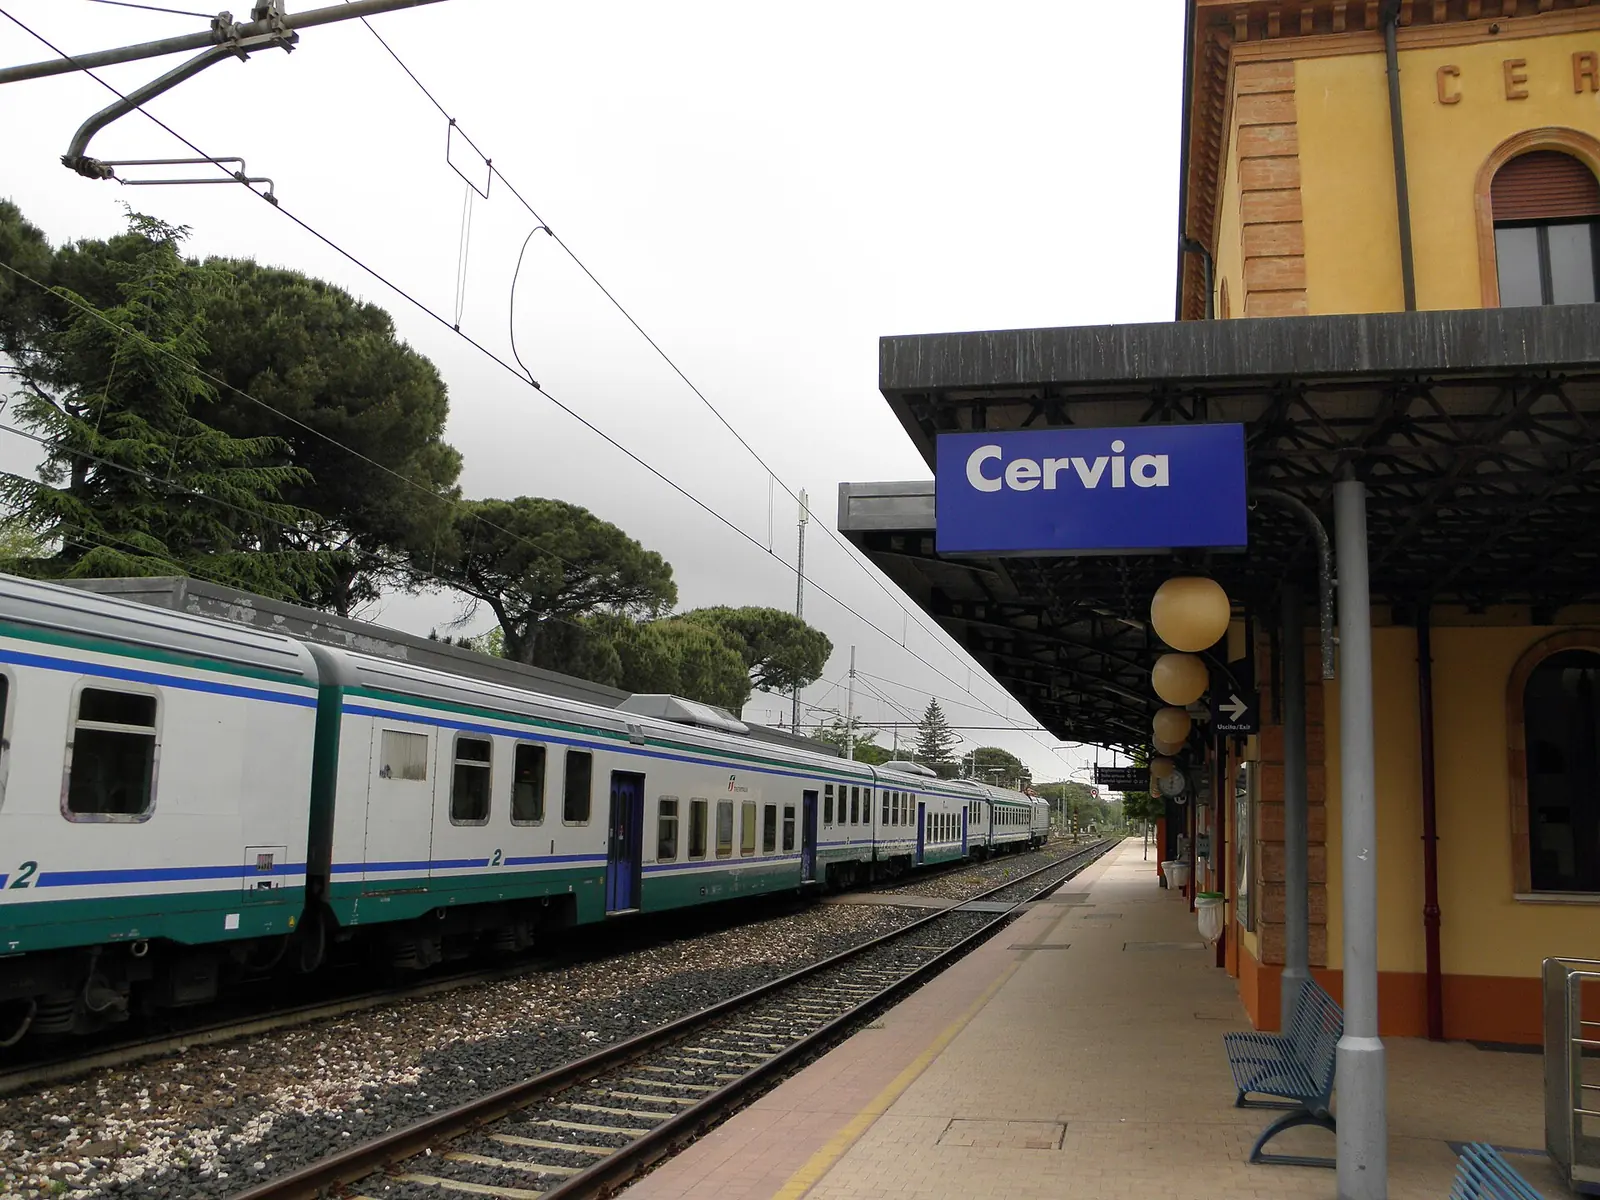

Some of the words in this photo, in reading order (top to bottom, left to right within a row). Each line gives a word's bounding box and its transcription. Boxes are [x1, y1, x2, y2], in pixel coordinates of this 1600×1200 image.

[965, 439, 1170, 492] Cervia
[491, 848, 502, 866] 2
[8, 860, 38, 889] 2
